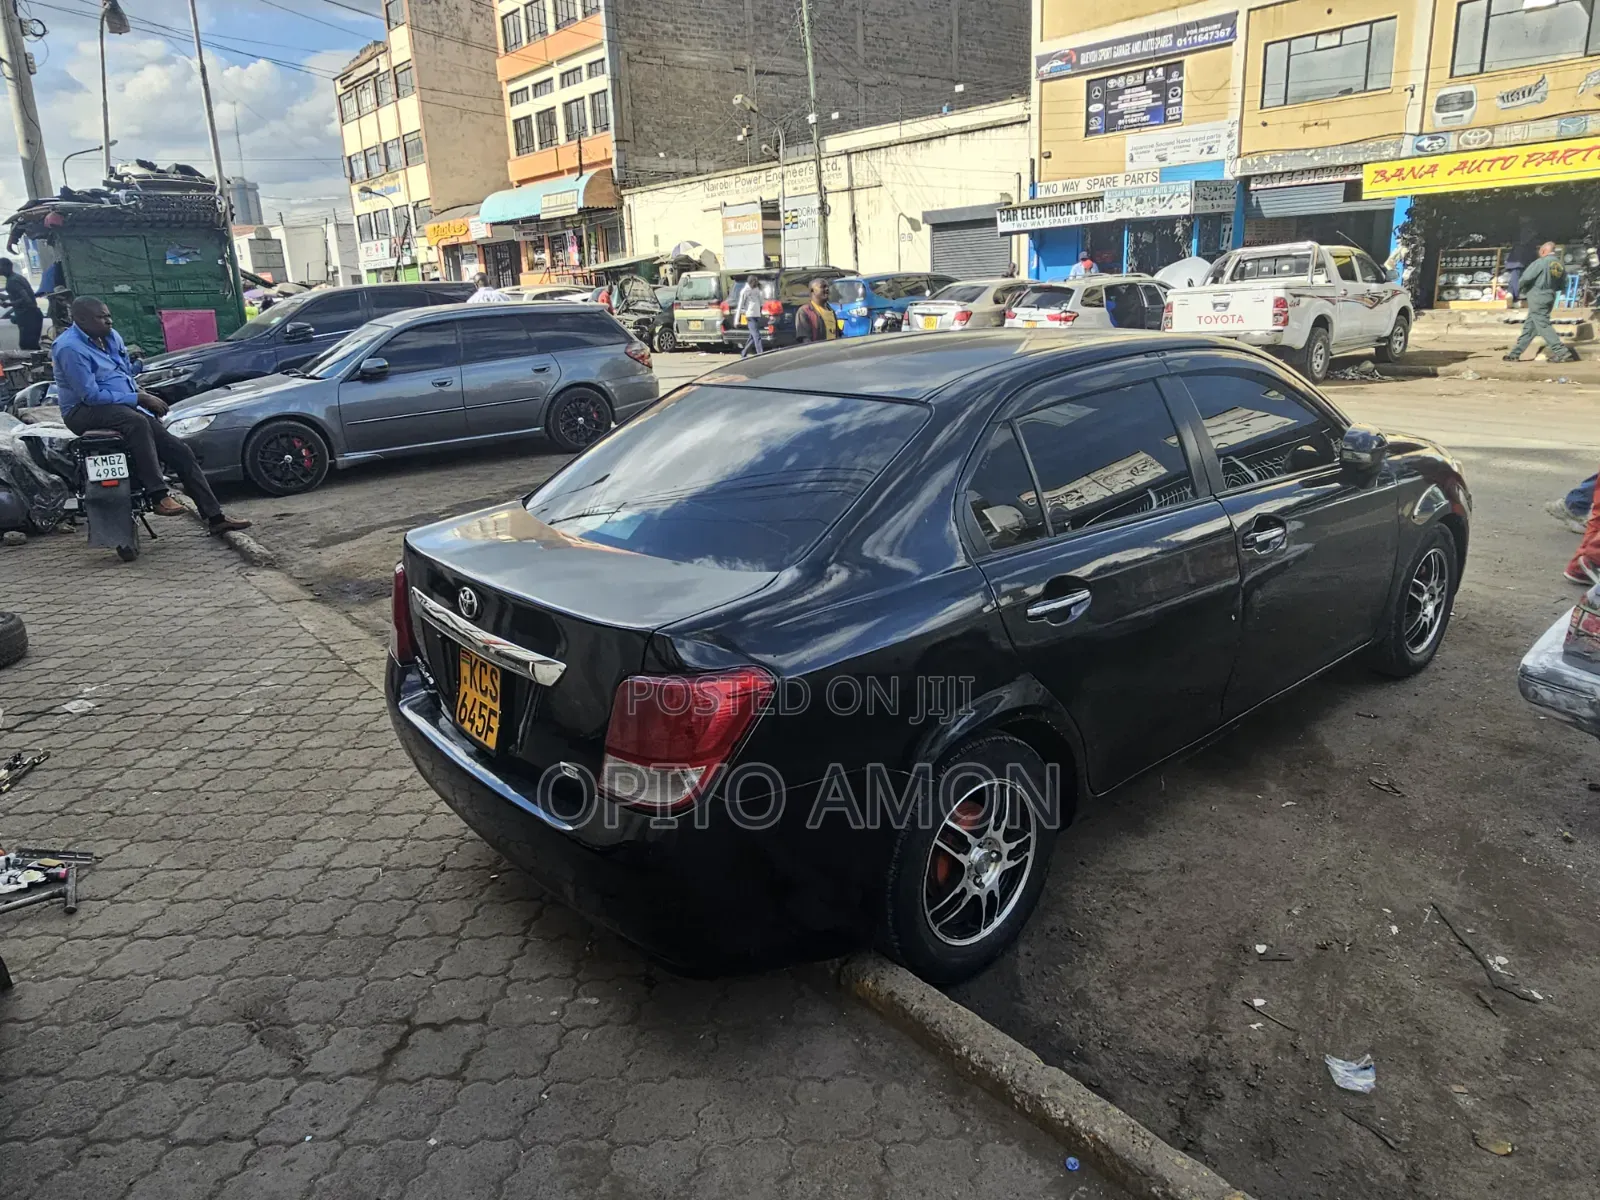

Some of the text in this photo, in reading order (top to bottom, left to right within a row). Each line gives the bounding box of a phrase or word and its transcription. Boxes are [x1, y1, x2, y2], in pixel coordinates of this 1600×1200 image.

[1176, 28, 1232, 46] 0111647367
[1176, 136, 1191, 145] Hand
[1192, 134, 1206, 143] used
[1206, 133, 1222, 142] parts
[1371, 144, 1600, 186] BANA AUTO PART
[703, 180, 732, 193] Nairobi
[734, 174, 762, 189] Power
[1038, 170, 1159, 196] TWO WAY SPARE PARTS
[999, 207, 1019, 223] CAR
[1020, 202, 1079, 221] ELECTRICAL
[1011, 214, 1099, 229] TWO WAY SPARE PARTS
[798, 217, 816, 229] SMITH
[1196, 313, 1245, 326] TOYOTA
[93, 455, 124, 467] KMGZ
[96, 467, 125, 478] 498C
[468, 654, 499, 704] KCS
[458, 691, 498, 742] 645F
